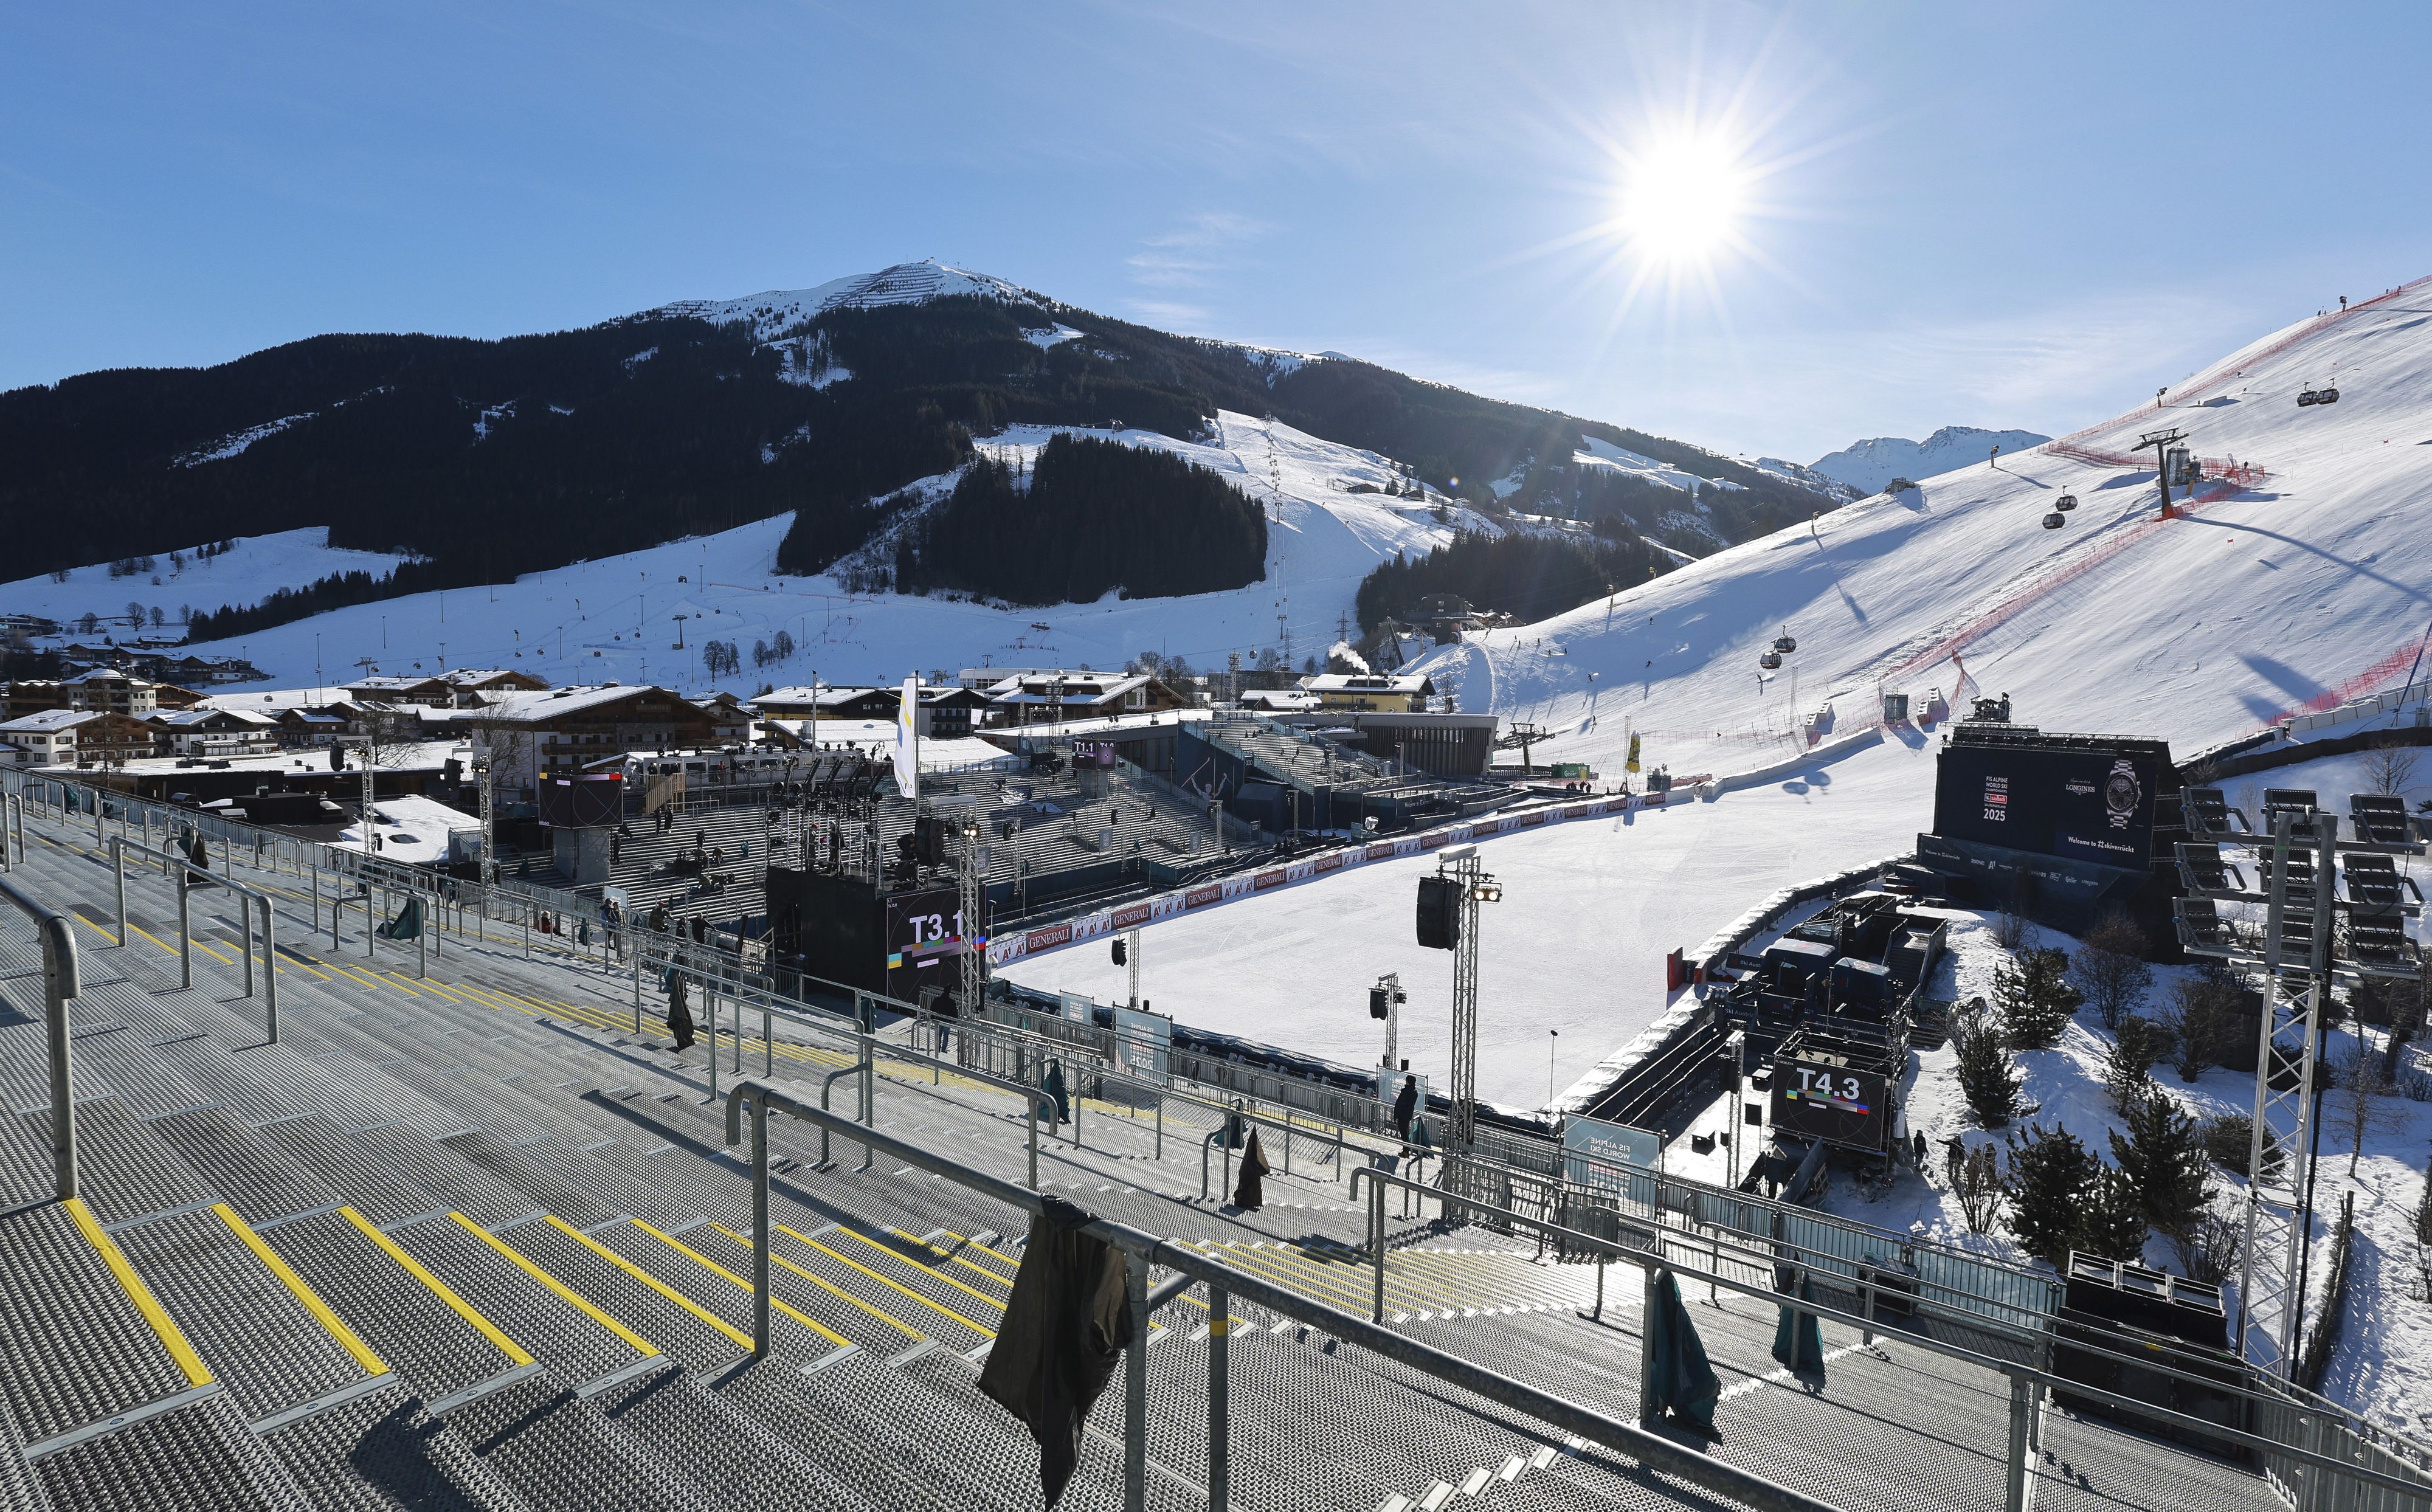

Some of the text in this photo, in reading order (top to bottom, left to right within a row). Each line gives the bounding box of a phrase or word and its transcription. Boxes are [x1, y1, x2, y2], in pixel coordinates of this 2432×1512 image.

[1075, 742, 1093, 751] T1.1
[2066, 784, 2095, 793] LONGINES
[1608, 801, 1626, 810] GENERALI
[1646, 795, 1665, 804] GENERALI
[1566, 807, 1586, 816] GENERALI
[1983, 809, 2005, 821] 2025
[1522, 814, 1542, 824] GENERALI
[1475, 823, 1496, 834] GENERALI
[1397, 841, 1420, 854] A1 A1 A1
[1423, 835, 1447, 847] GENERALI
[2068, 837, 2090, 846] Welcome
[1344, 851, 1366, 865] A1 A1 A1
[1368, 846, 1393, 857] GENERALI
[1316, 856, 1341, 871] GENERALI
[1256, 872, 1285, 887] GENERALI
[1289, 865, 1313, 881] A1 A1 A1
[1188, 888, 1220, 905] GENERALI
[1225, 881, 1252, 898] A1 A1 A1
[1154, 899, 1184, 917] A1 A1 A1
[1114, 908, 1149, 925] GENERALI
[910, 910, 963, 944] T3.1
[1075, 919, 1109, 939] A1 A1 A1
[1029, 928, 1069, 948] GENERALI
[1003, 947, 1010, 961] A1
[1016, 942, 1024, 956] A1
[1797, 1068, 1859, 1100] T4.3
